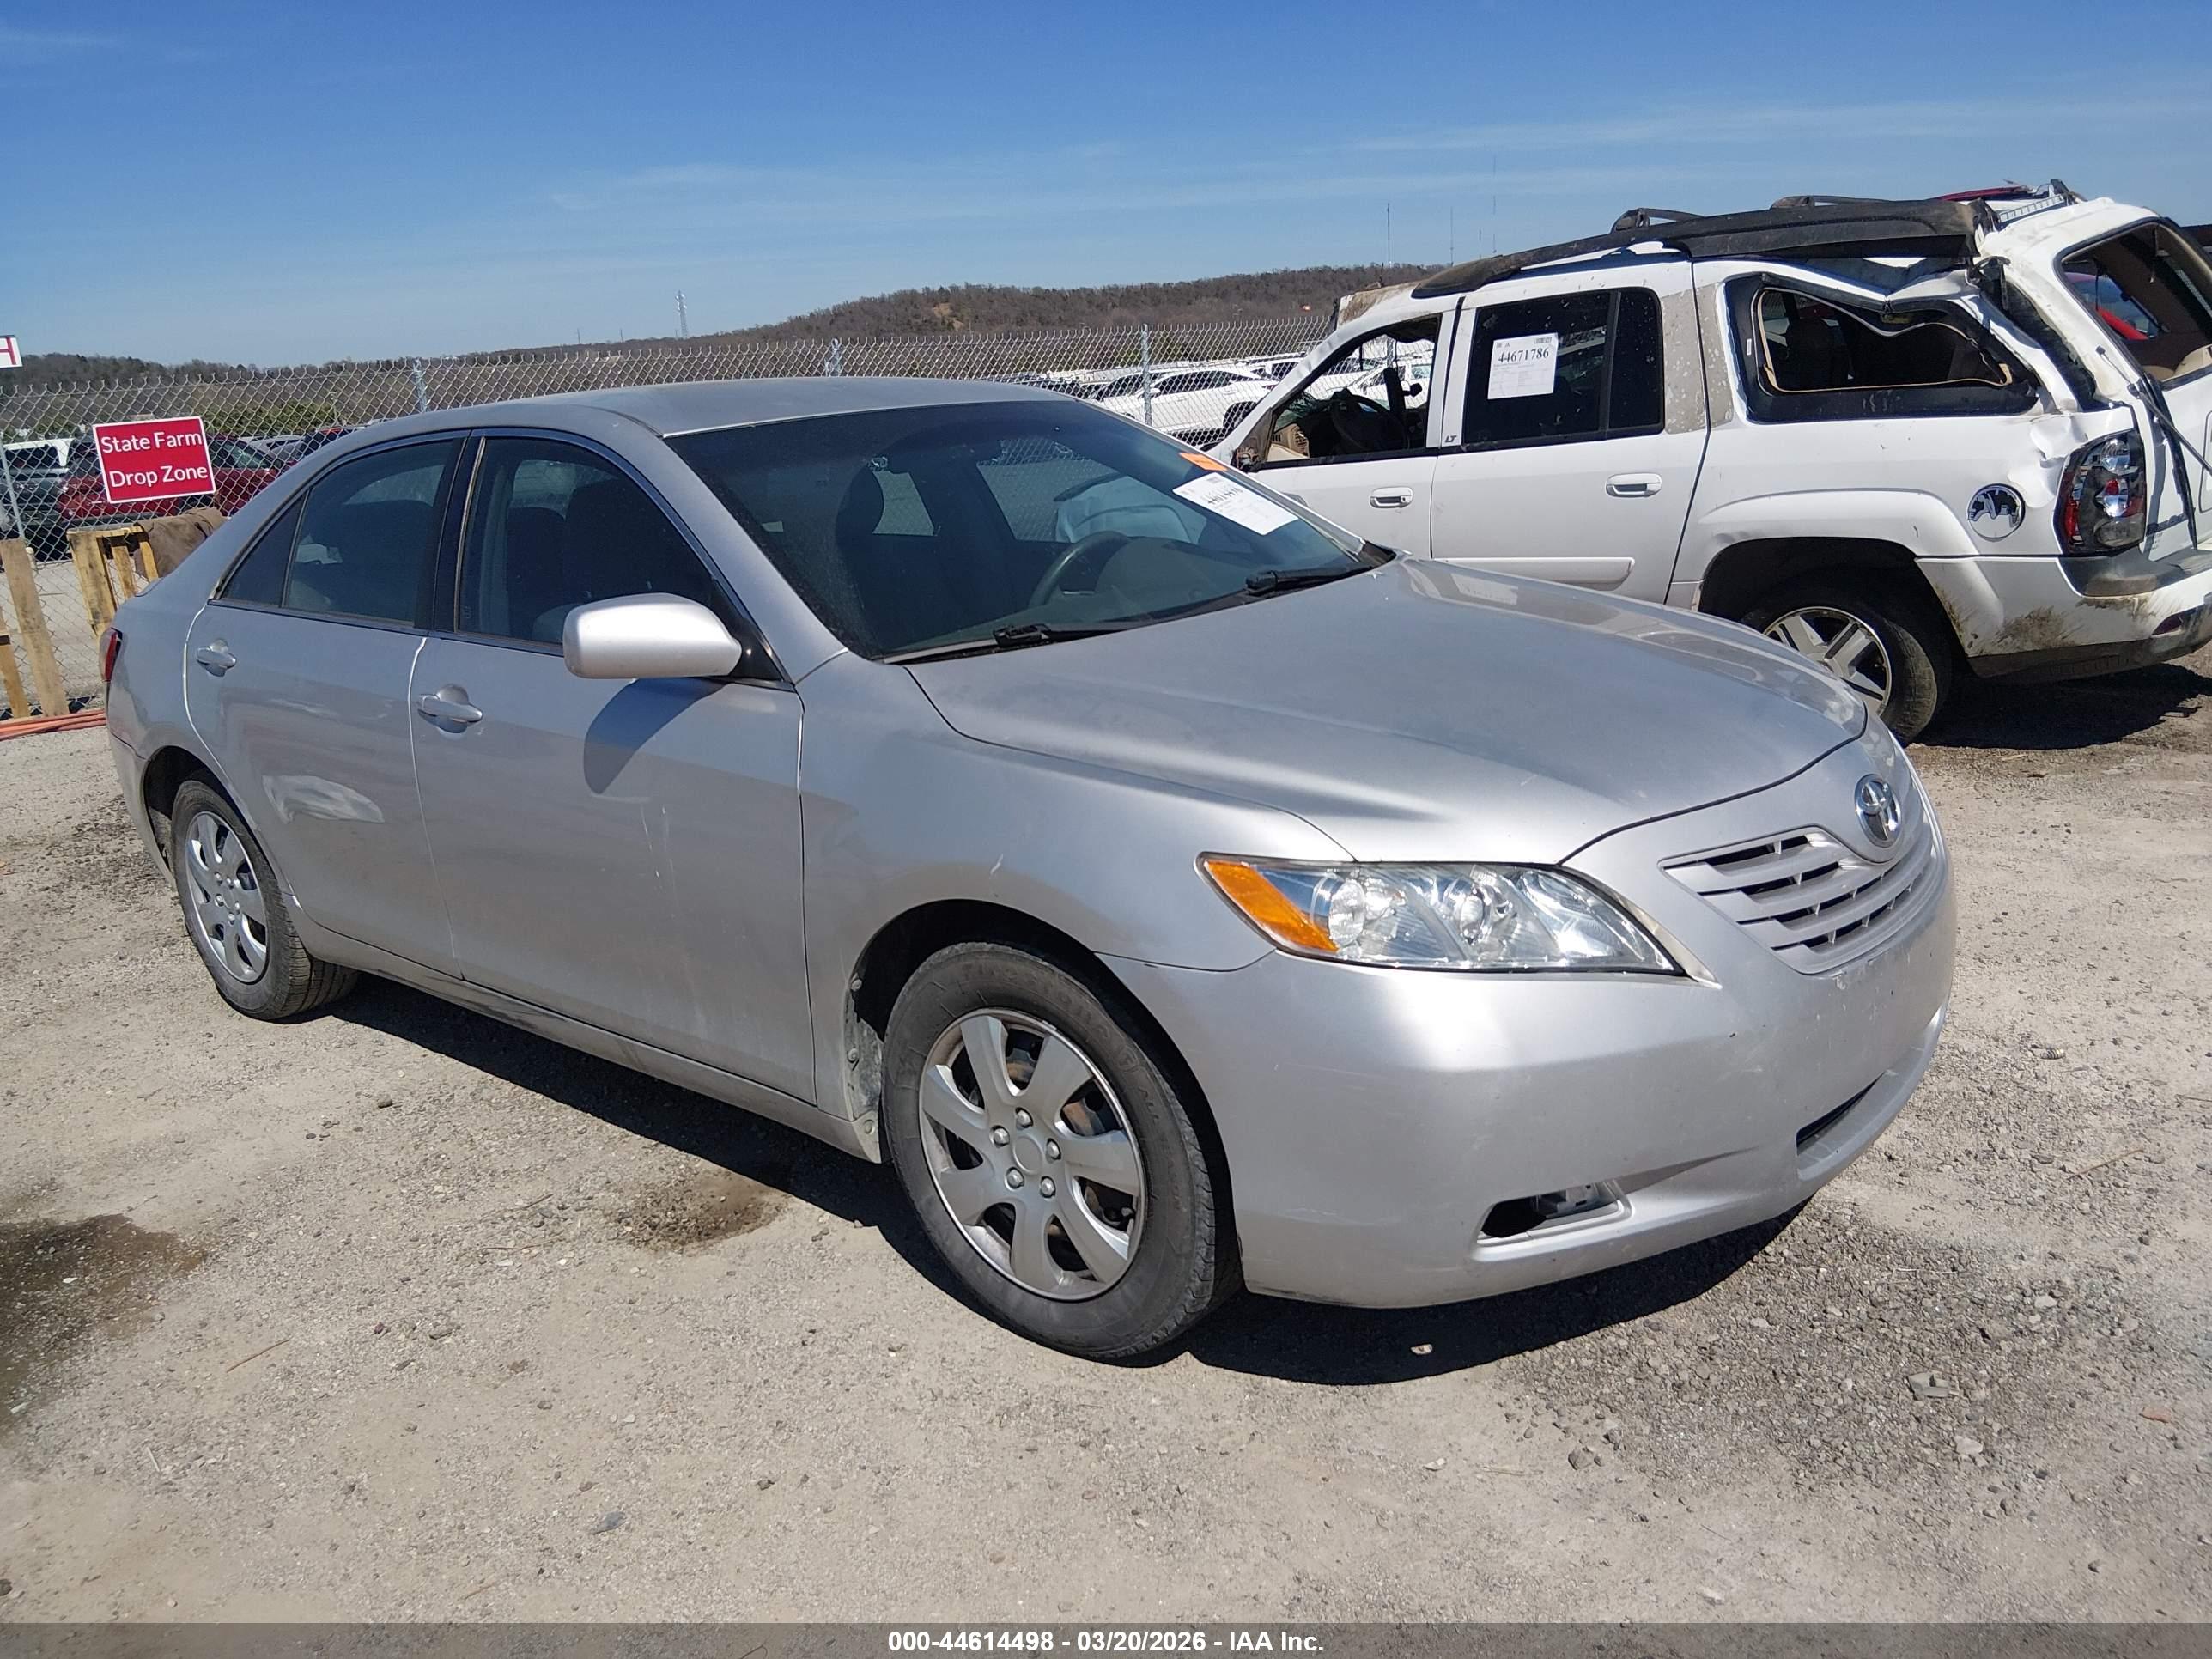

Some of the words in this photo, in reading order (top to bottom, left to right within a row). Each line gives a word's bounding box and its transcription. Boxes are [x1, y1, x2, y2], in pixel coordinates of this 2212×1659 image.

[1498, 348, 1549, 363] 44671786
[101, 436, 151, 453] State
[154, 431, 202, 448] Farm
[109, 471, 158, 488] Drop
[160, 465, 208, 483] Zone
